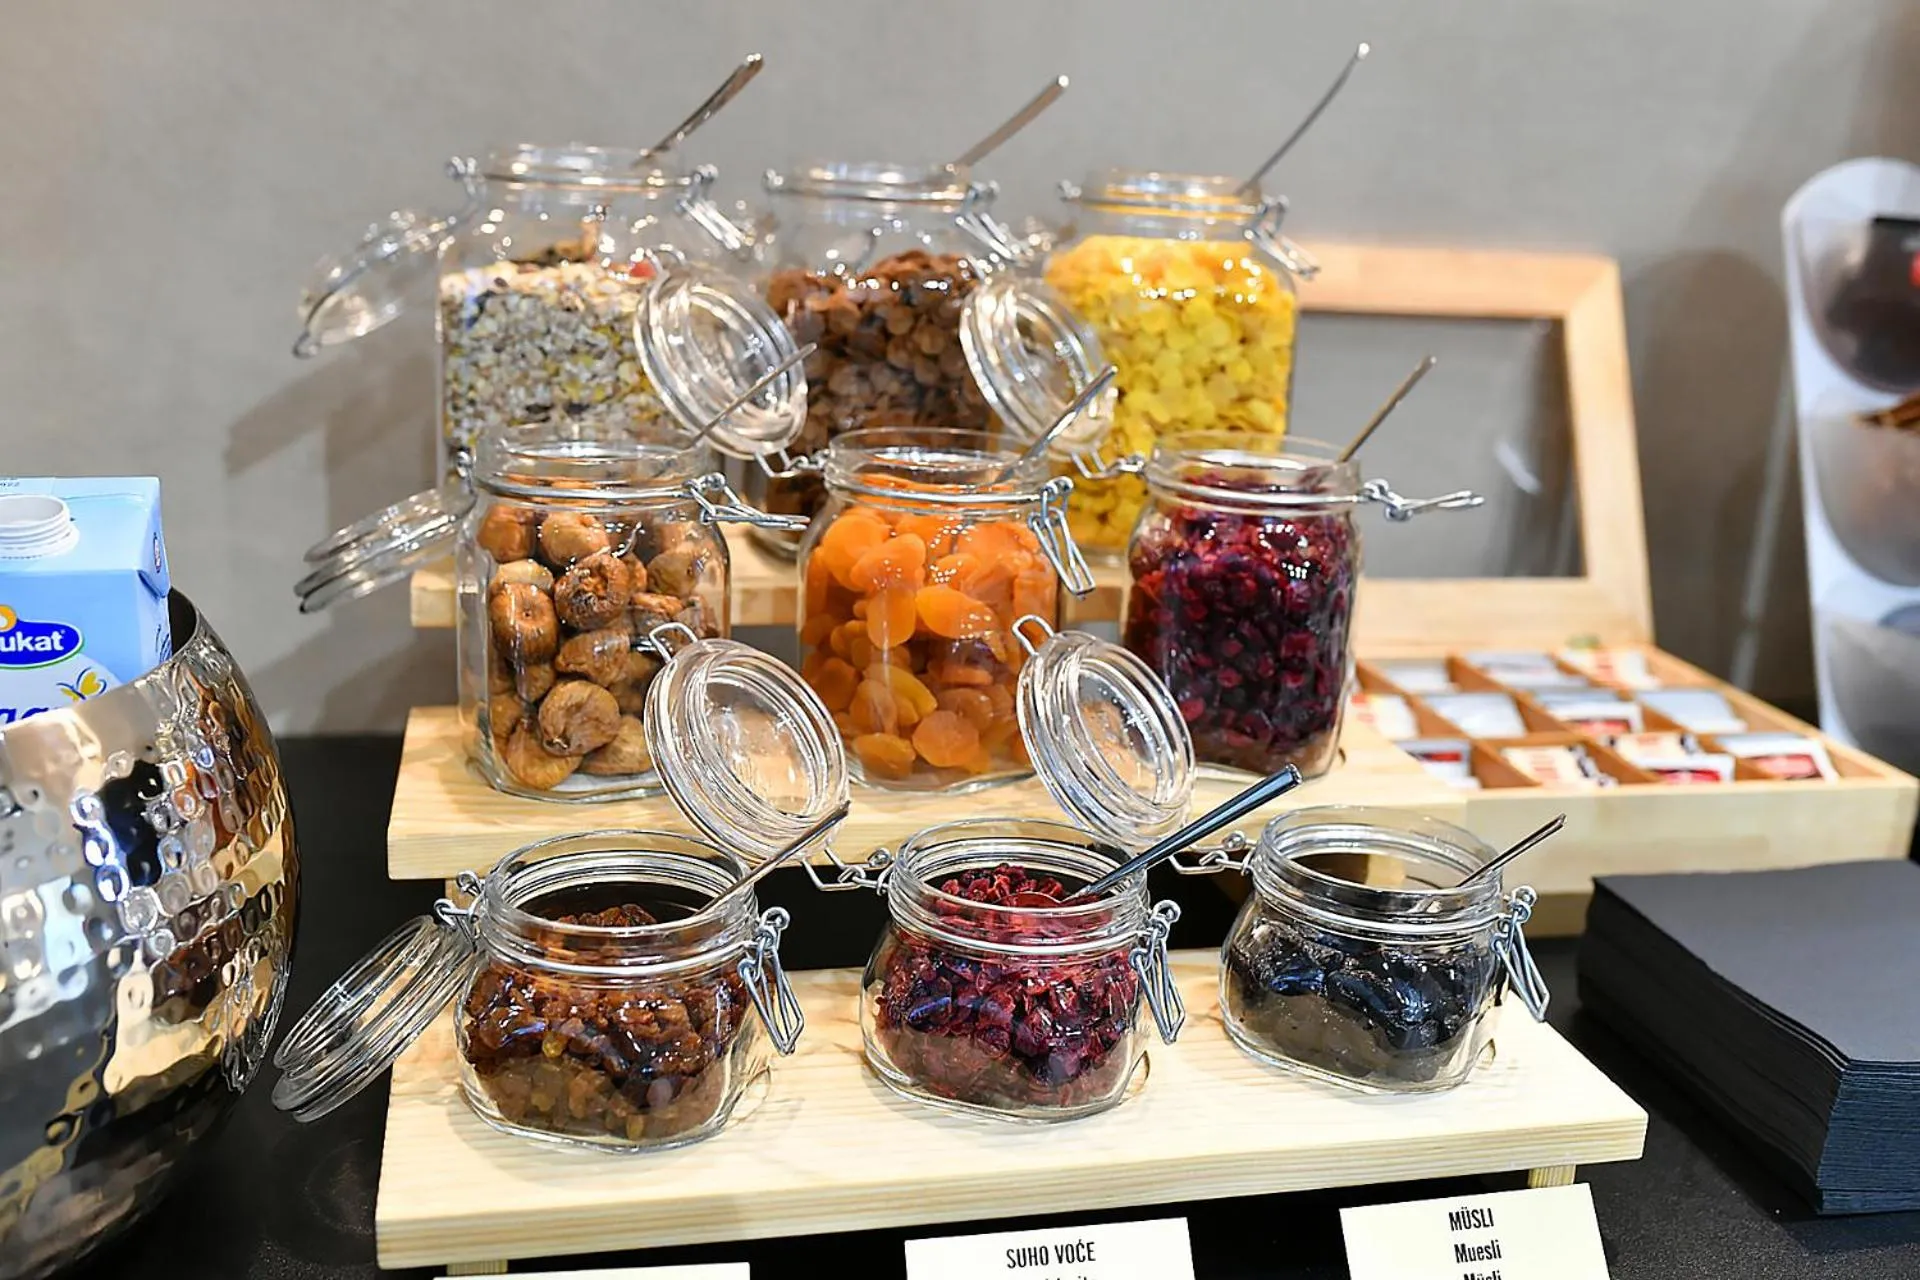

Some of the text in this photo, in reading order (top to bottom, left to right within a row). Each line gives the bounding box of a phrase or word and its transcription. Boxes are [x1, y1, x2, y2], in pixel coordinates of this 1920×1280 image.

[1448, 1206, 1494, 1231] MÜSLI
[1006, 1239, 1096, 1269] SUHO VOĆE
[1454, 1239, 1502, 1264] Muesli
